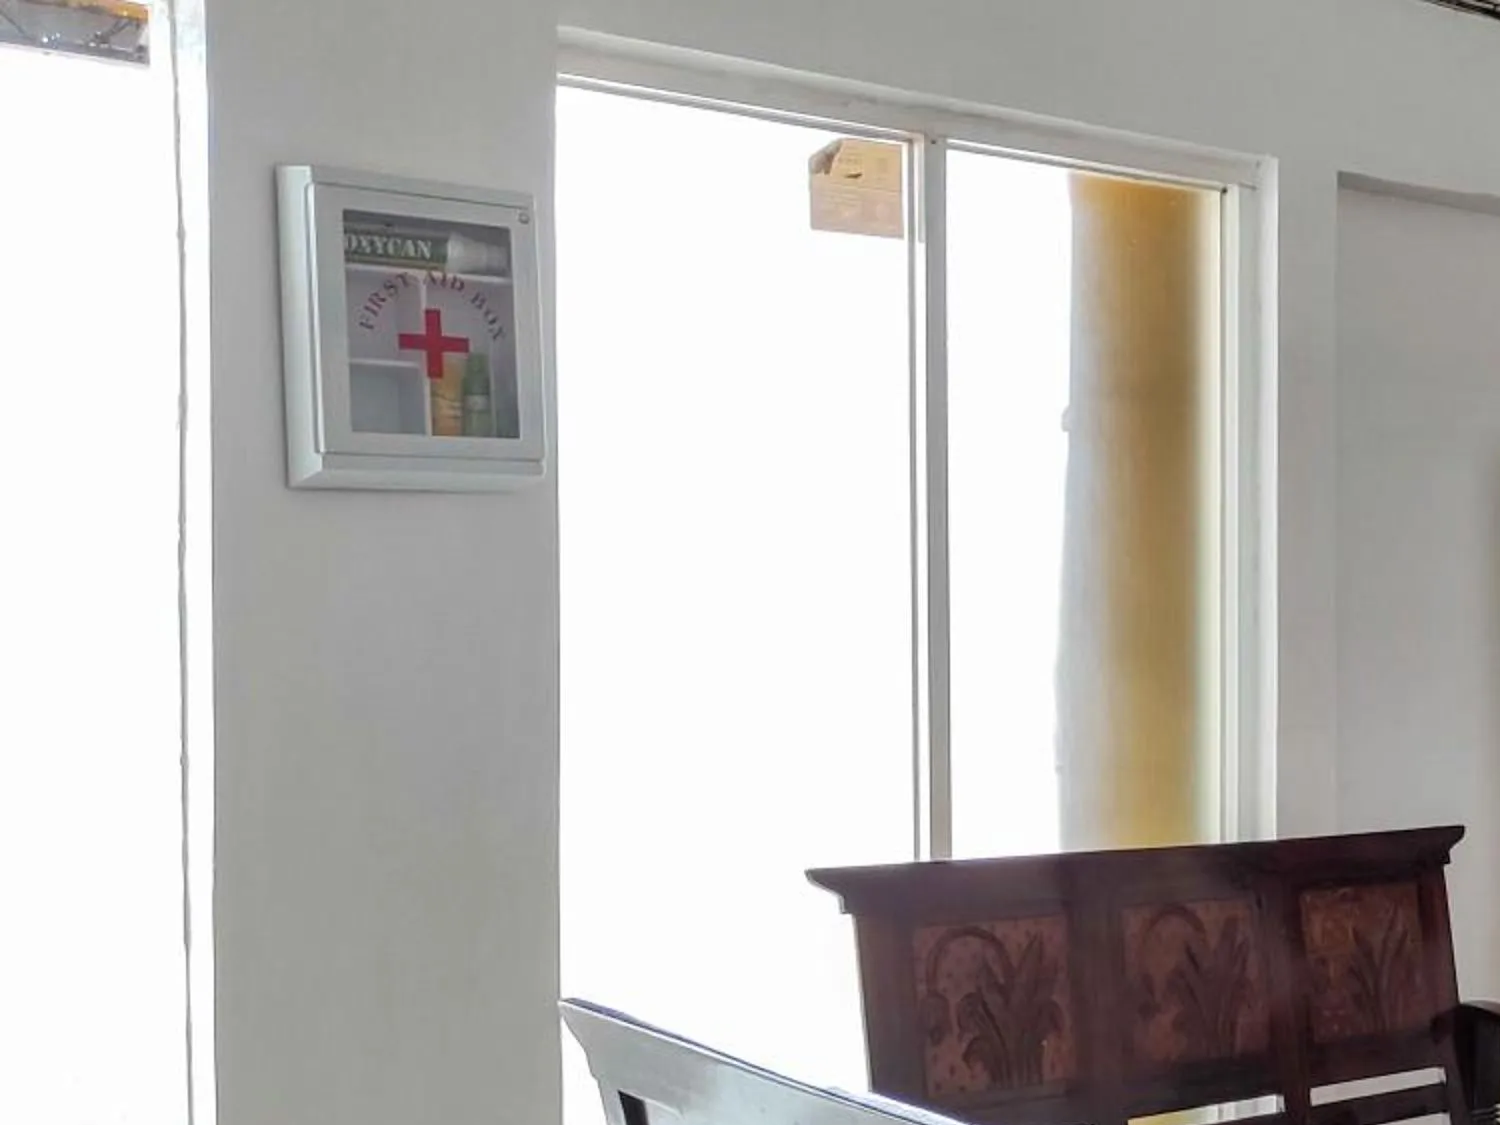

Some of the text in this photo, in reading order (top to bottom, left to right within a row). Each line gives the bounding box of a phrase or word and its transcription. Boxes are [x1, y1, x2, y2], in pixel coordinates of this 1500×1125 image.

[358, 271, 507, 342] FIRST AID BOX
